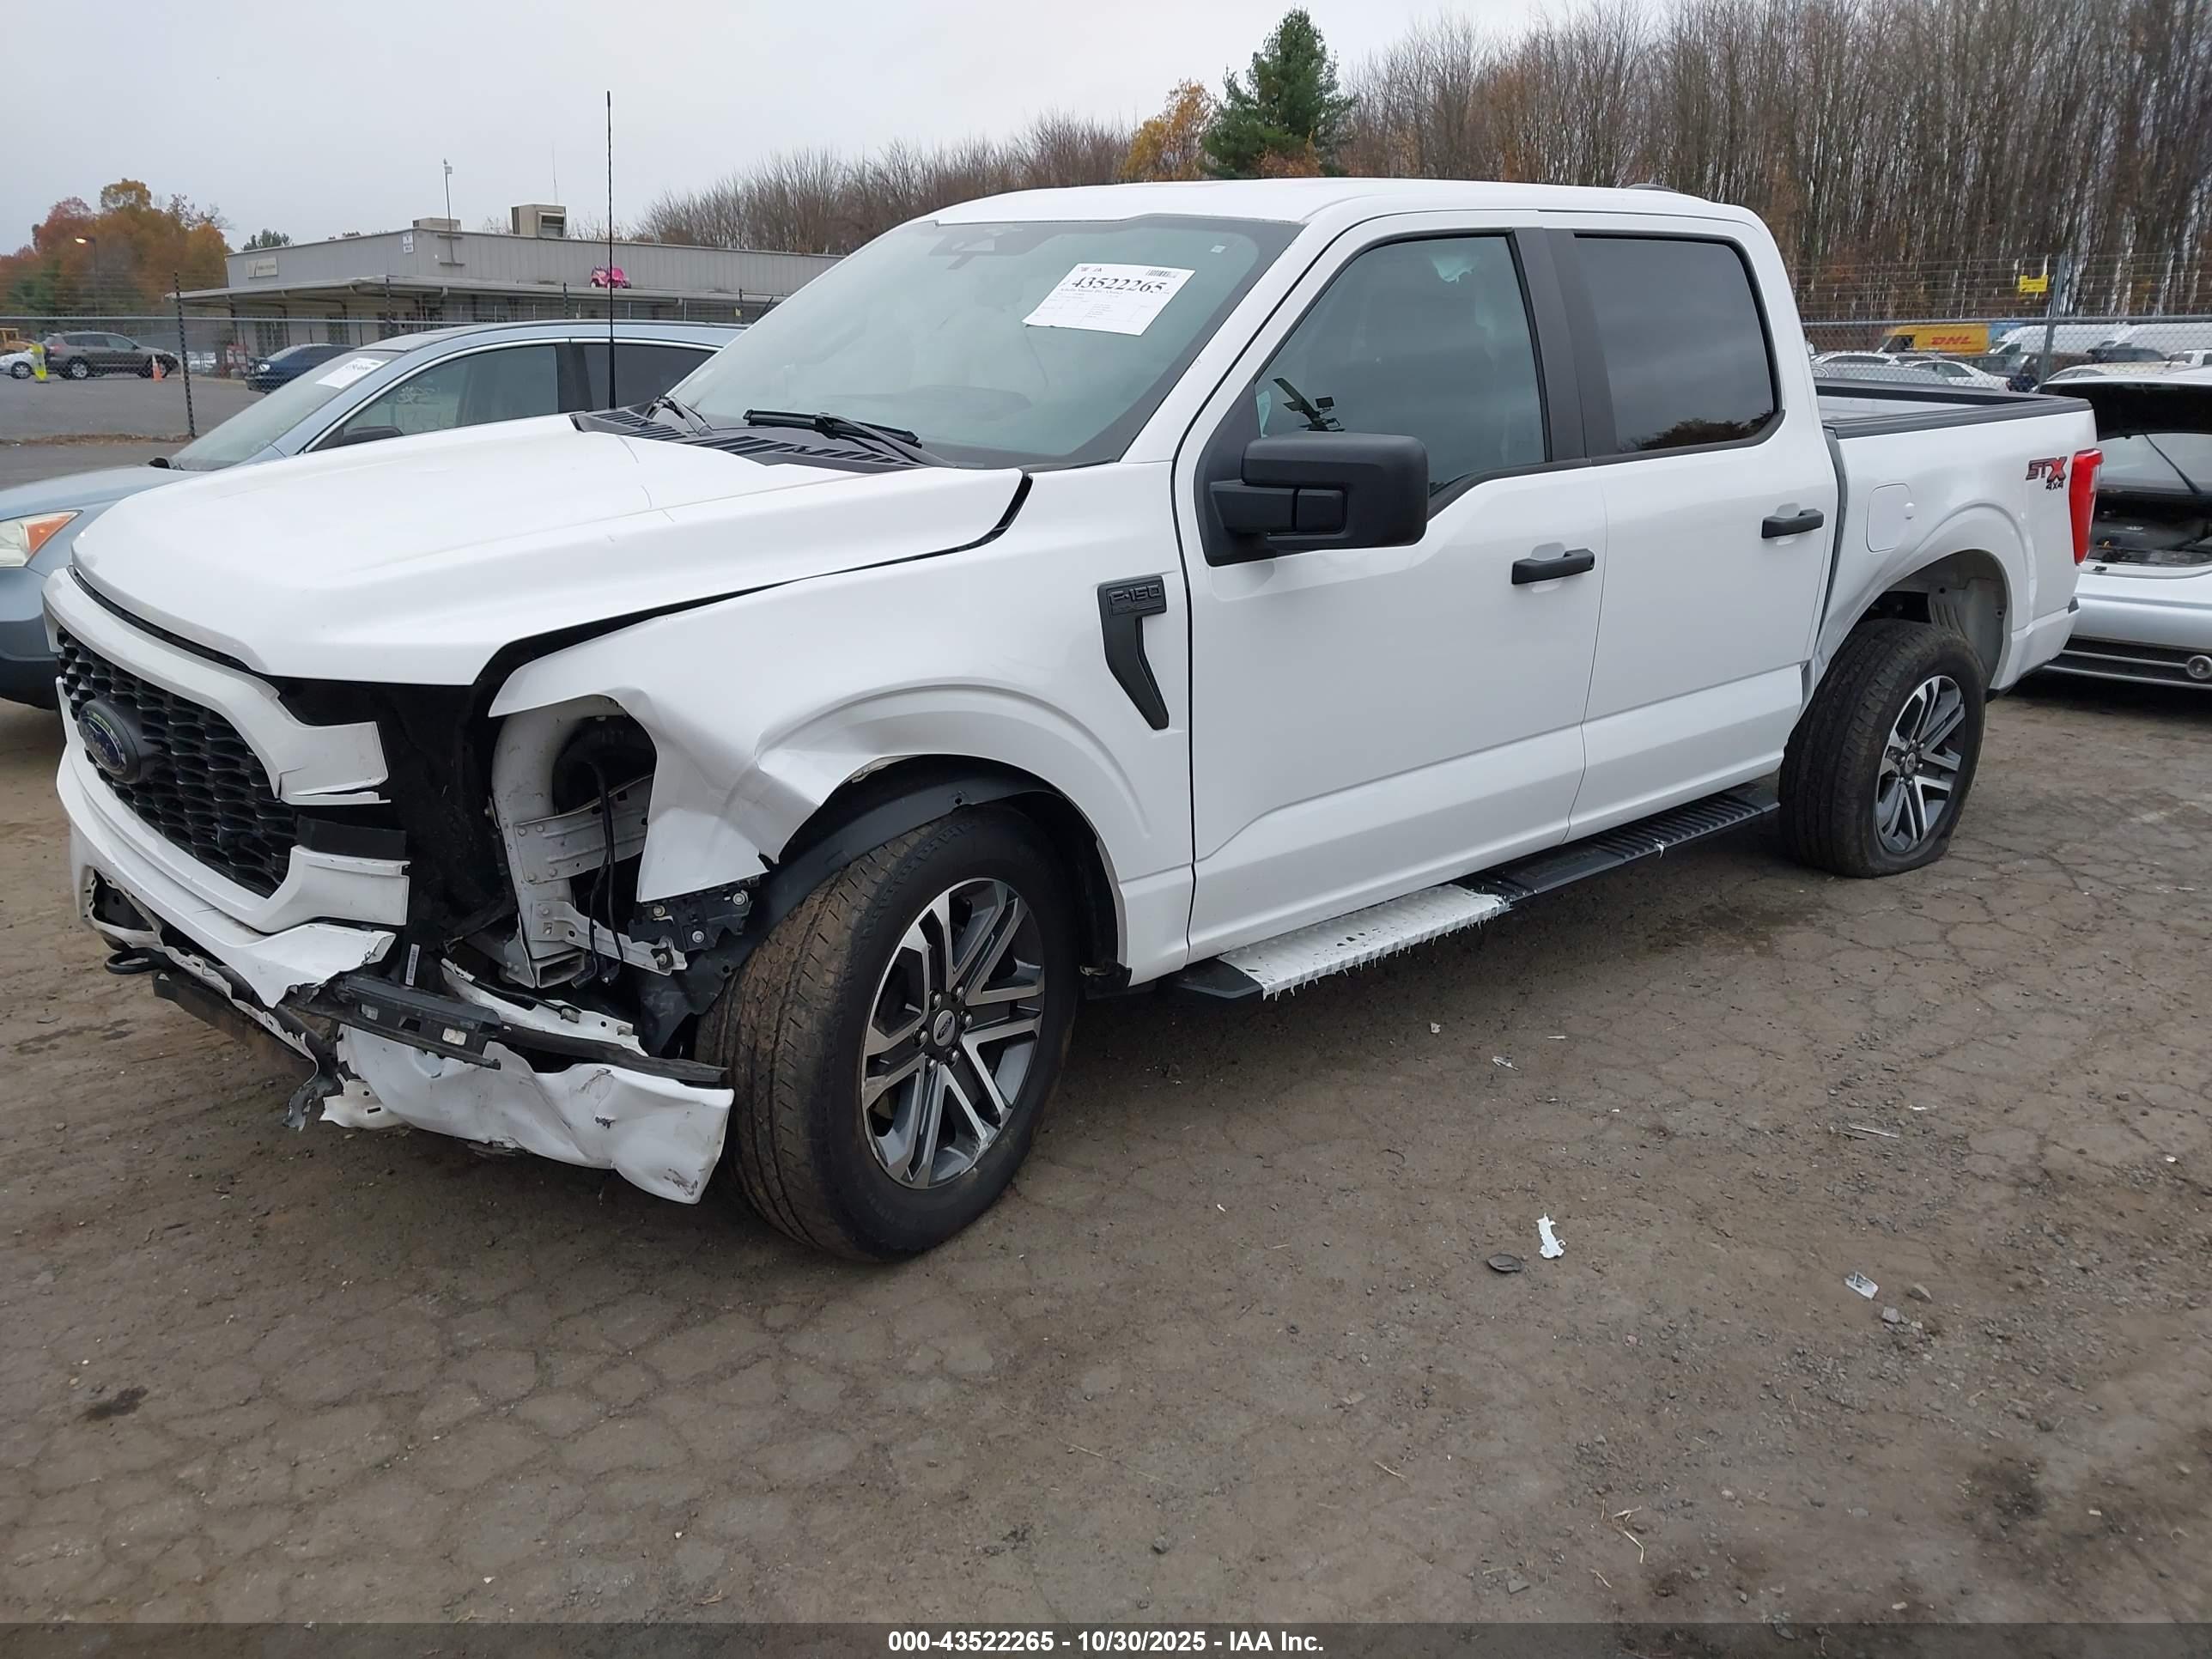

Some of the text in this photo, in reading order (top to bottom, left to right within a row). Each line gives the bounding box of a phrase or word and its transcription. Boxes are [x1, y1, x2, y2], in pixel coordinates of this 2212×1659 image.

[1072, 276, 1168, 294] 43522265
[1931, 336, 1972, 346] DHL
[2026, 456, 2068, 483] STX
